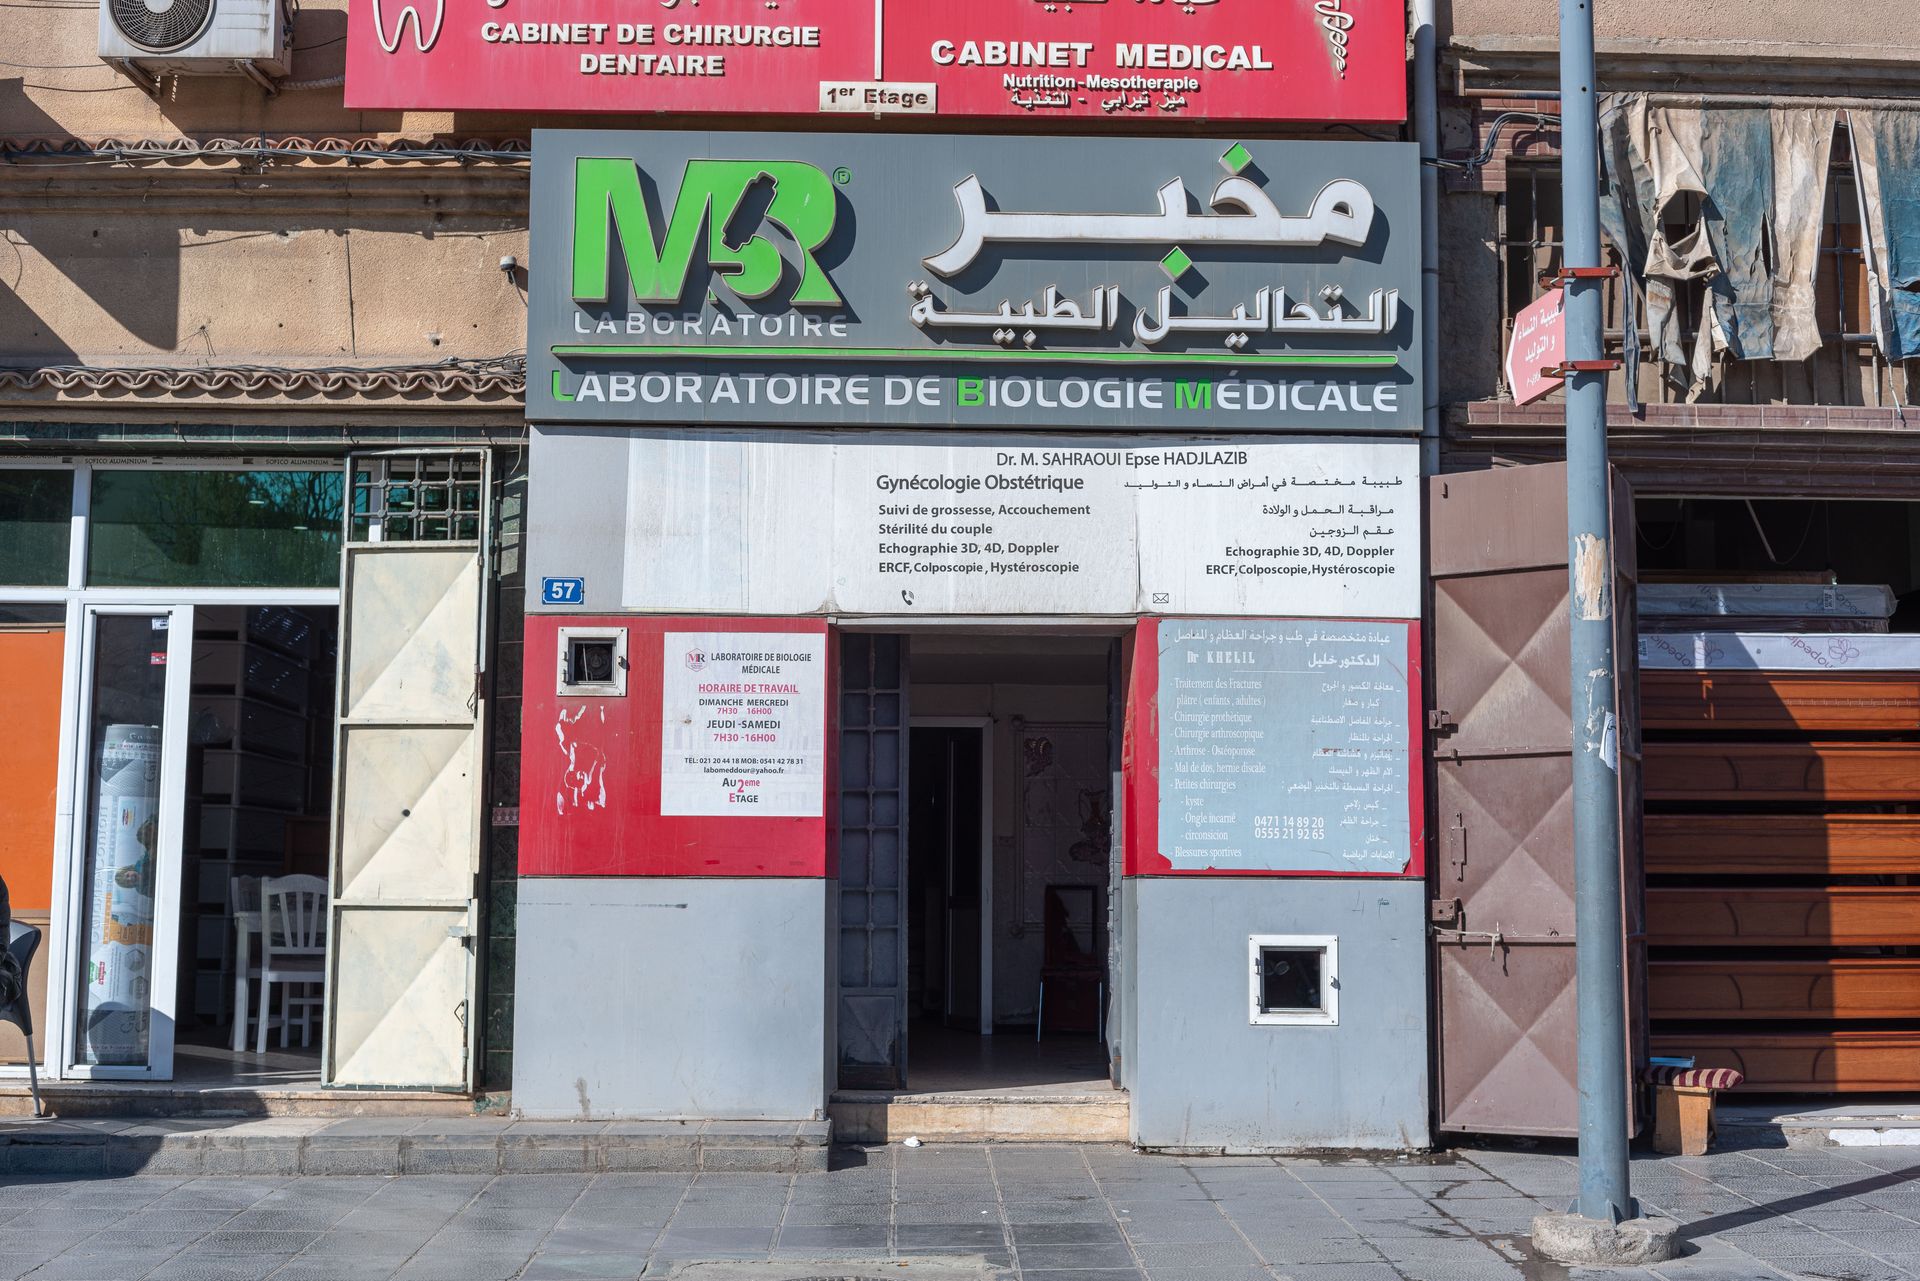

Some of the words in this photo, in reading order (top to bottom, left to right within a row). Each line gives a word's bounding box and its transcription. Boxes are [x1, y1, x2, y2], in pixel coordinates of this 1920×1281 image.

[481, 23, 608, 44] CABINET
[618, 24, 653, 44] DE
[663, 24, 820, 47] CHIRURGIE
[930, 39, 1094, 66] CABINET
[1115, 43, 1273, 70] MEDICAL
[580, 54, 725, 76] DENTAIRE
[1003, 74, 1075, 88] Nutrition
[826, 86, 855, 104] 1er
[863, 88, 928, 108] Etage
[1011, 88, 1069, 109] التغذية
[922, 141, 1374, 281] مخبر
[907, 280, 1118, 345] الطبية
[1134, 284, 1399, 349] التحاليل
[574, 311, 847, 338] LABORATOIRE
[552, 370, 869, 406] LABORATOIRE
[885, 375, 940, 406] DE
[957, 376, 1164, 409] BIOLOGIE
[1175, 370, 1398, 412] MÉDICALE
[997, 452, 1016, 466] Dr.
[1021, 452, 1037, 466] M.
[1042, 452, 1120, 466] SAHRAOUI
[1126, 453, 1160, 468] Epse
[1164, 452, 1247, 465] HADJLAZIB
[877, 474, 980, 493] Gynécologie
[985, 474, 1084, 493] Obstétrique
[1124, 480, 1180, 490] التوليد
[1192, 478, 1234, 488] النساء
[1238, 476, 1269, 489] أمراض
[1272, 478, 1286, 491] في
[1291, 477, 1356, 486] مختصة
[1362, 476, 1402, 488] طبيبة
[878, 504, 909, 515] Suivi
[912, 504, 928, 515] de
[932, 506, 995, 518] grossesse,
[998, 504, 1091, 515] Accouchement
[1262, 504, 1290, 517] الولادة
[1301, 505, 1345, 516] الحمل
[1348, 505, 1393, 517] مراقبة
[879, 523, 928, 534] Stérilité
[931, 524, 947, 534] du
[950, 524, 992, 536] couple
[1310, 525, 1359, 538] الزوجين
[1363, 526, 1394, 539] عقم
[879, 543, 958, 556] Echographie
[961, 544, 981, 555] 3D,
[984, 544, 1004, 555] 4D,
[1008, 543, 1059, 556] Doppler
[1226, 546, 1300, 559] Echographie
[1303, 547, 1321, 558] 3D,
[1325, 547, 1343, 558] 4D,
[1347, 546, 1394, 559] Doppler
[551, 582, 576, 599] 57
[711, 653, 763, 661] LABORATOIRE
[765, 653, 775, 661] DE
[776, 653, 812, 662] BIOLOGIE
[1187, 651, 1199, 663] Dr
[1207, 651, 1255, 664] KHELIL
[1339, 653, 1380, 668] الدكتور
[742, 664, 780, 674] MÉDICALE
[699, 684, 741, 693] HORAIRE
[744, 684, 756, 693] DE
[759, 684, 798, 693] TRAVAIL
[1175, 678, 1213, 688] Traitement
[1215, 678, 1227, 688] des
[1230, 678, 1262, 688] Fractures
[707, 720, 735, 729] JEUDI
[1175, 711, 1210, 726] Chirurgie
[714, 734, 738, 742] 7H30
[1175, 727, 1209, 742] Chirurgie
[1175, 744, 1206, 755] Arthrose
[1175, 762, 1188, 772] Mal
[1191, 762, 1199, 772] de
[1241, 762, 1265, 773] discale
[1175, 779, 1198, 789] Petites
[1200, 778, 1236, 793] chirurgies
[1185, 812, 1207, 827] Ongle
[1255, 816, 1278, 827] 0471
[1283, 816, 1294, 827] 14
[1297, 817, 1309, 827] 89
[1312, 817, 1324, 828] 20
[1255, 828, 1280, 839] 0555
[1283, 828, 1293, 839] 21
[1298, 829, 1309, 839] 92
[1312, 829, 1324, 840] 65
[1175, 846, 1208, 857] Blessures
[1210, 846, 1242, 860] sportives
